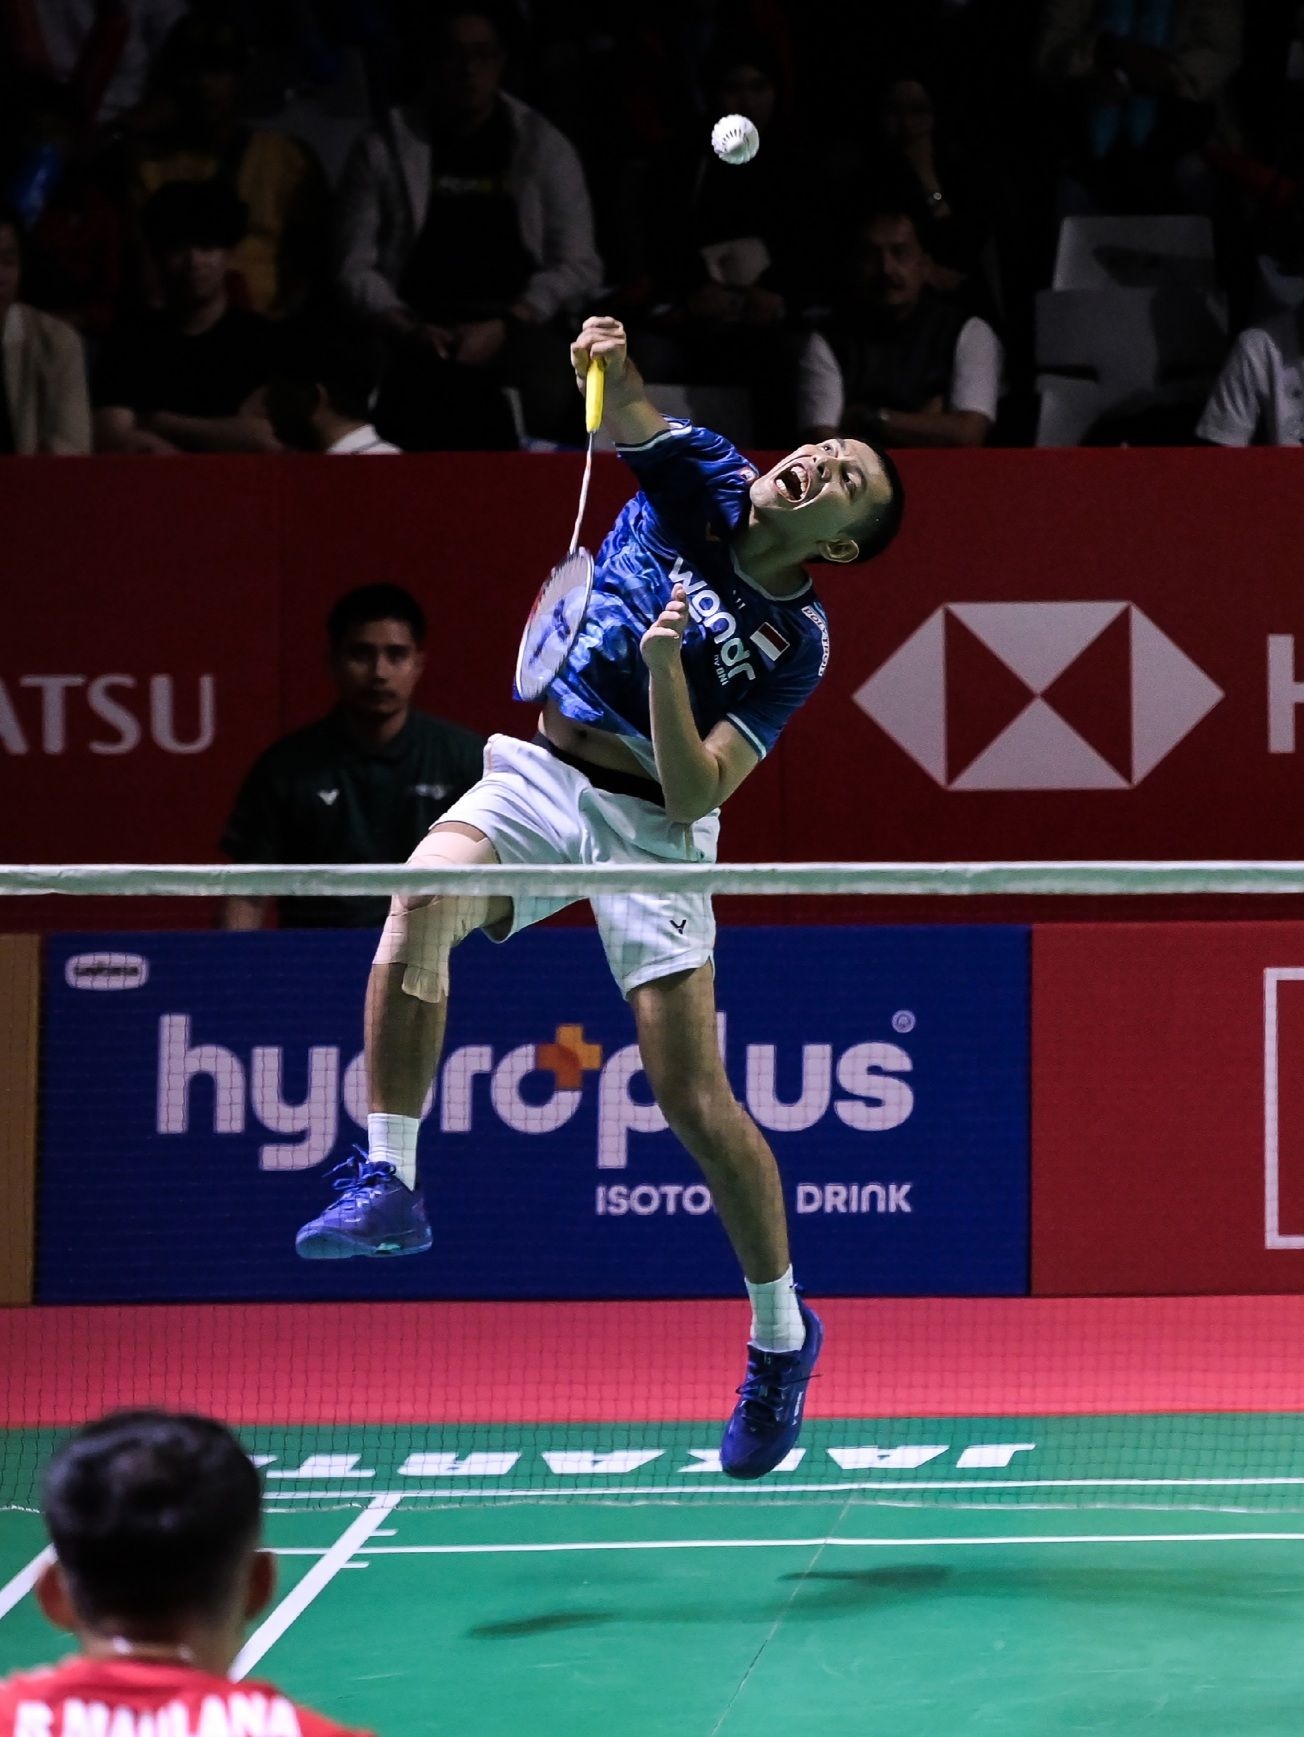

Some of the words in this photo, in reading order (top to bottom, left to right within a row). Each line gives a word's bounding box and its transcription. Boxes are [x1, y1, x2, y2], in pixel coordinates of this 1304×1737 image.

[668, 557, 756, 681] wondr
[157, 1011, 915, 1171] hyropus
[596, 1183, 717, 1215] ISOTO
[797, 1182, 913, 1213] DRINK
[249, 1443, 1037, 1478] JAKART
